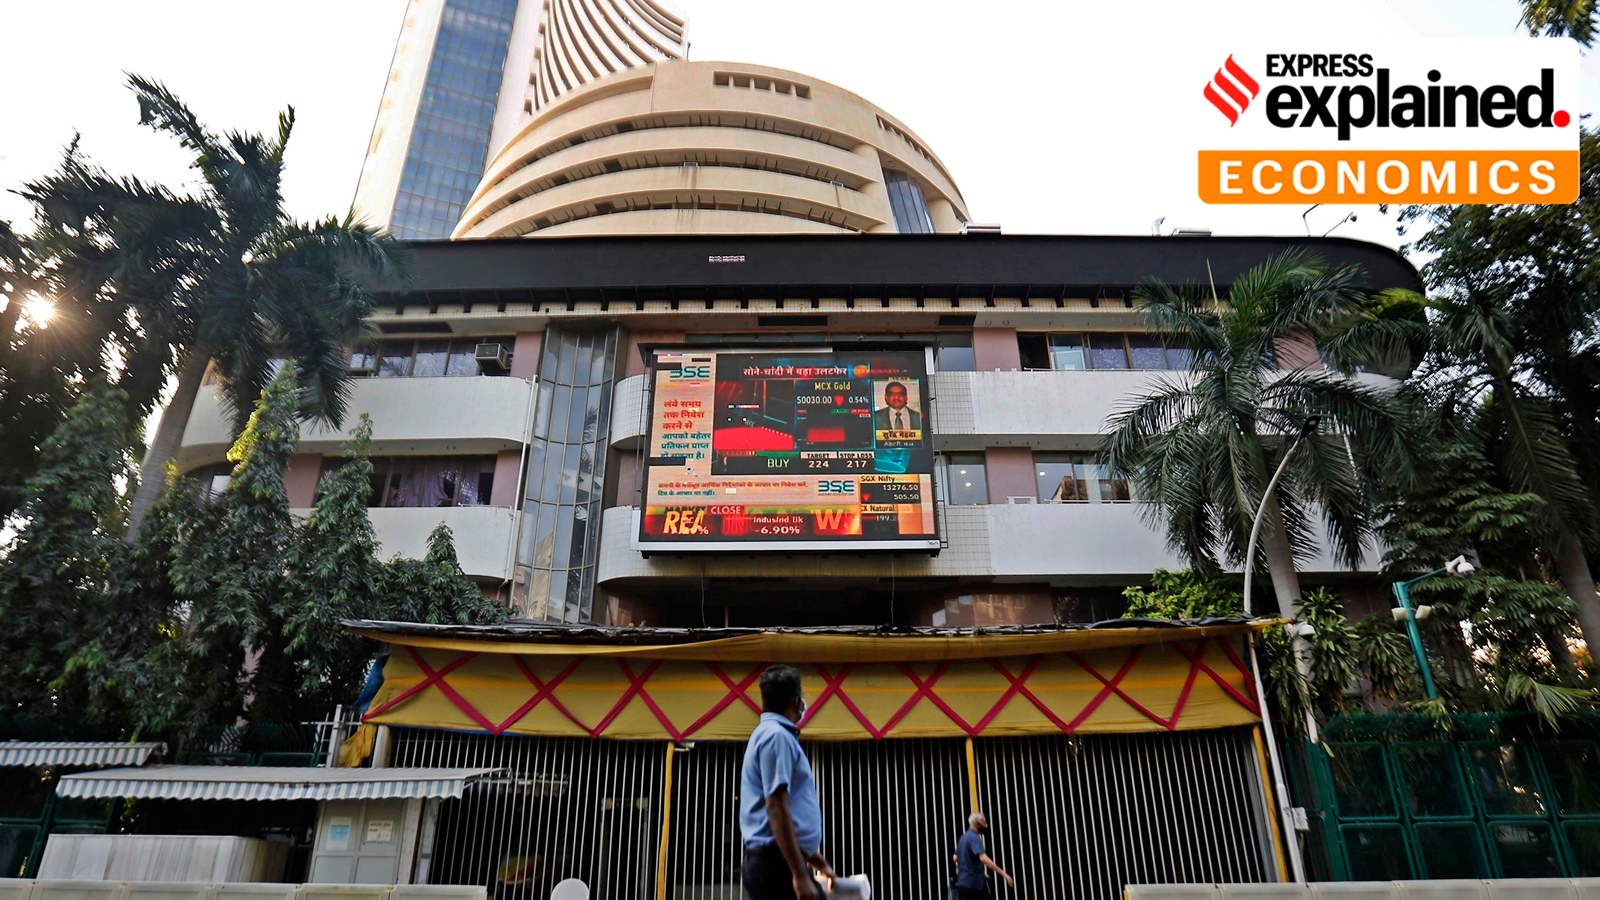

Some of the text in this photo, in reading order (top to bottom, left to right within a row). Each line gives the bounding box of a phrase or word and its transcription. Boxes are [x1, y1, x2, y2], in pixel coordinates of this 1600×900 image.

[786, 365, 794, 375] में
[815, 365, 847, 375] उलटफेर
[814, 381, 851, 391] MCX Gold
[796, 395, 833, 405] 50030.00
[848, 396, 869, 404] 0.54%
[681, 410, 704, 418] निवेश
[662, 420, 693, 429] करने से
[662, 431, 688, 439] आपको
[661, 441, 689, 449] प्रतिफल
[767, 459, 790, 468] BUY
[808, 460, 830, 468] 224
[846, 460, 867, 468] 217
[878, 475, 896, 483] Nifty
[818, 480, 855, 493] BSE
[711, 506, 741, 514] CLOSE
[755, 526, 800, 534] -6.90%
